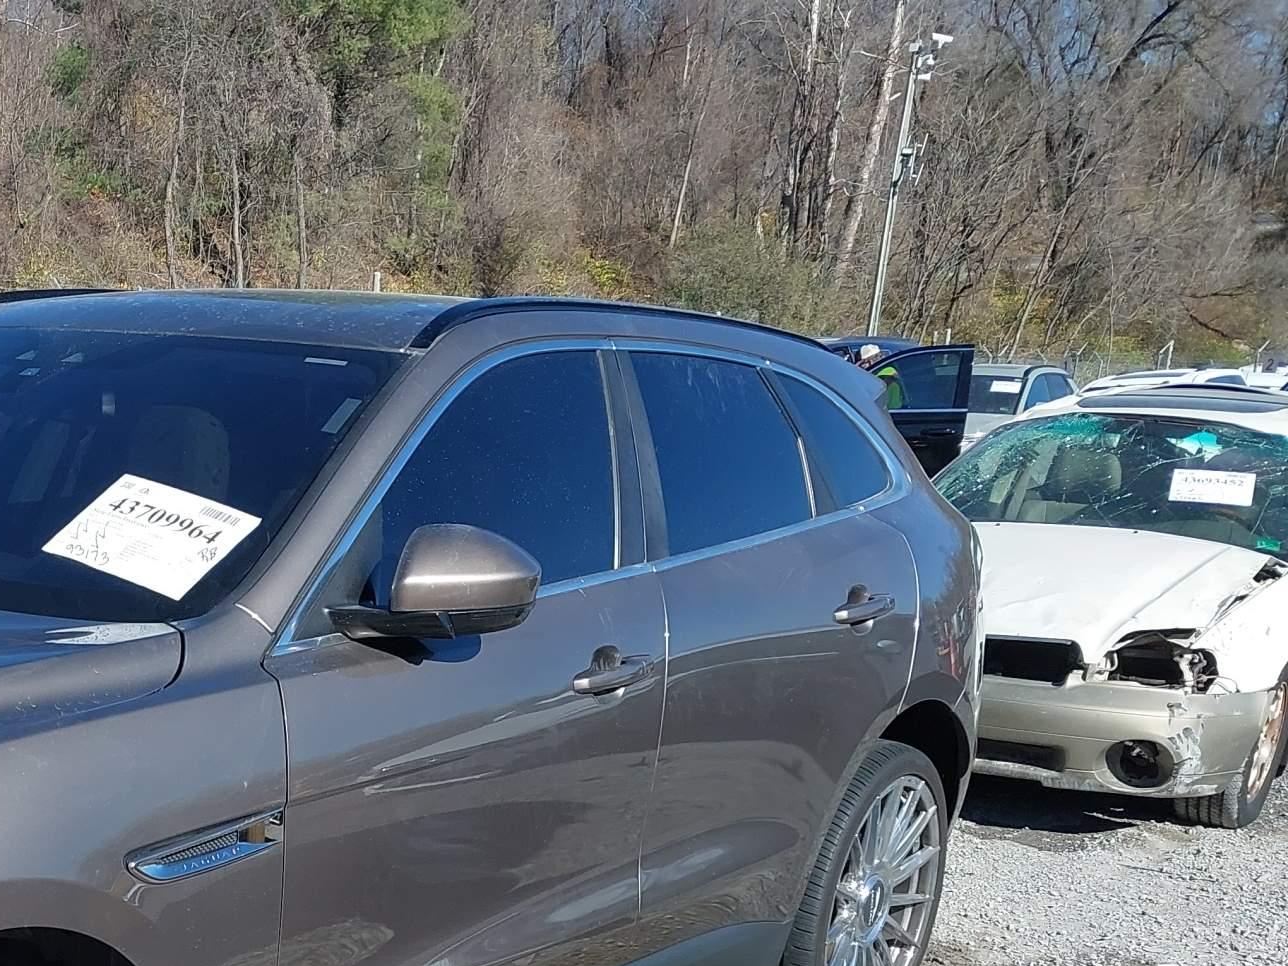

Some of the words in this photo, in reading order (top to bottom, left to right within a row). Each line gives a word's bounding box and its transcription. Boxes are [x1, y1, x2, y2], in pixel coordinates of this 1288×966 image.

[1265, 358, 1274, 371] 2
[109, 497, 223, 545] 43709964
[182, 847, 241, 871] JAGUAR
